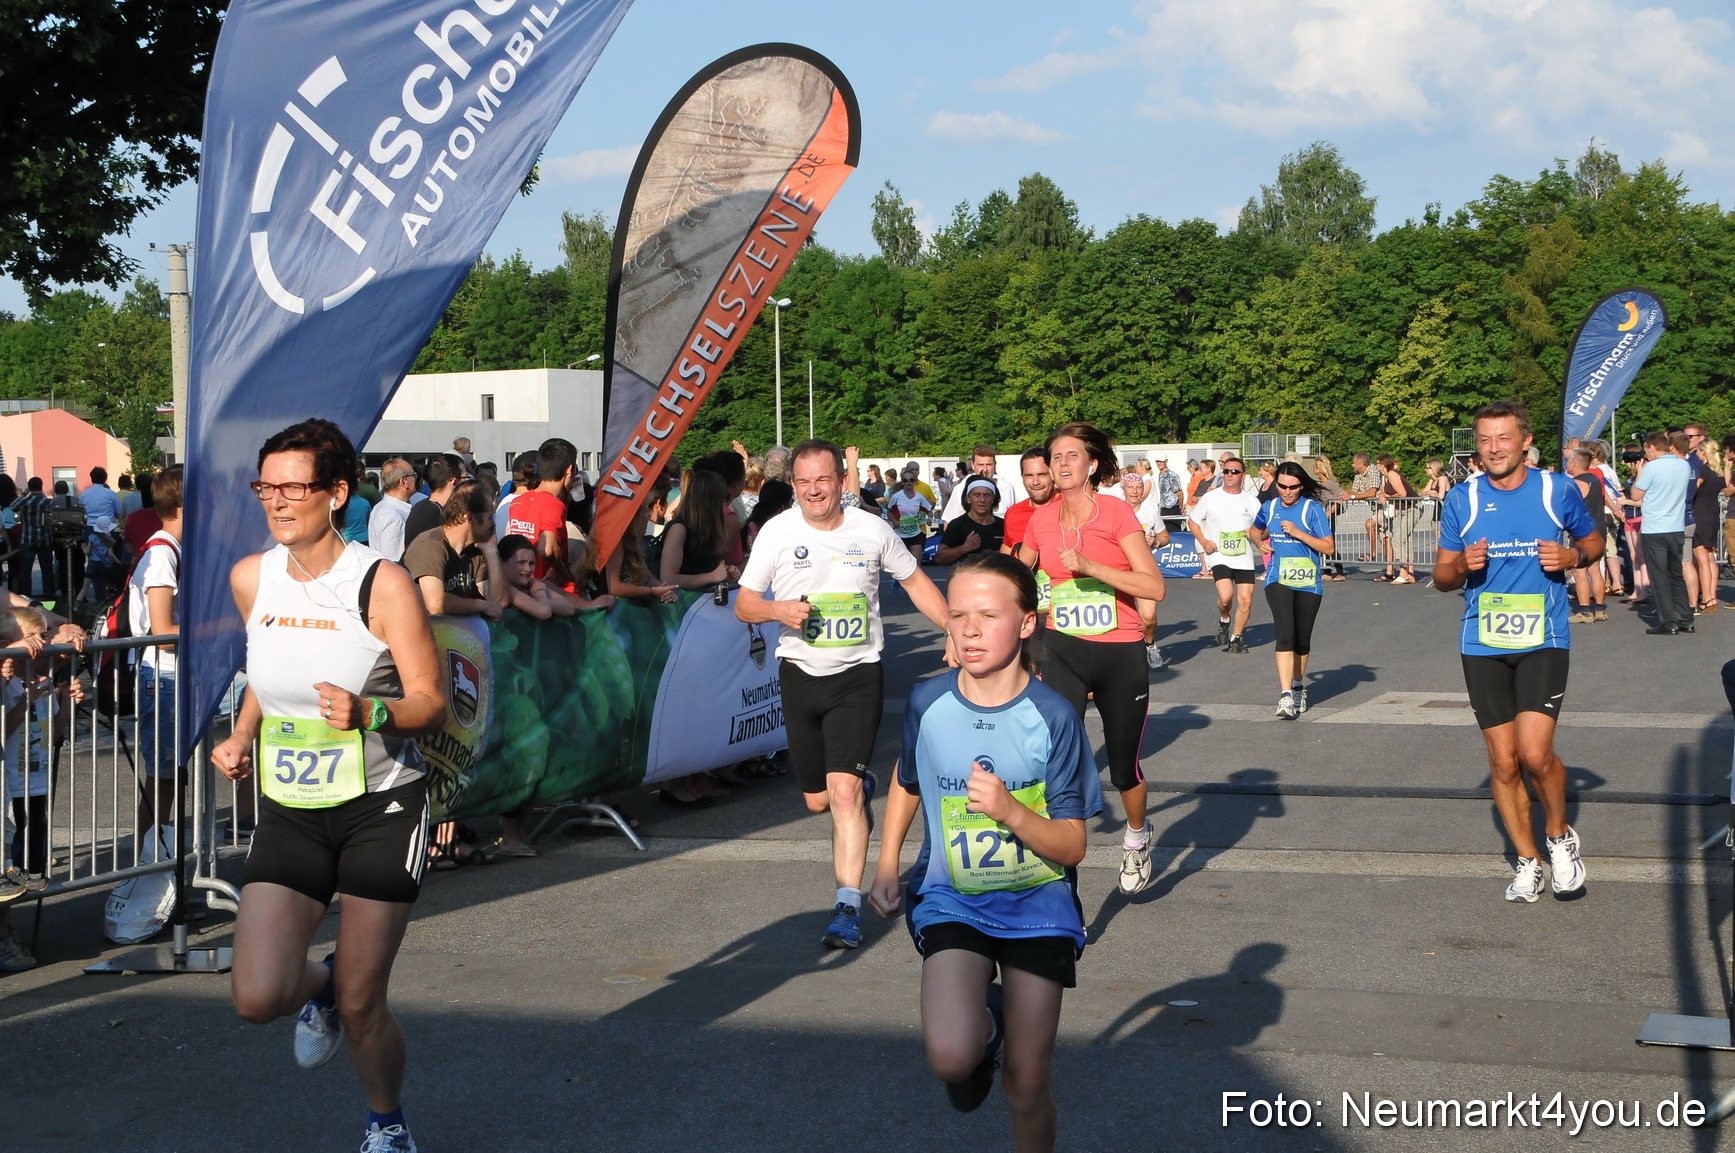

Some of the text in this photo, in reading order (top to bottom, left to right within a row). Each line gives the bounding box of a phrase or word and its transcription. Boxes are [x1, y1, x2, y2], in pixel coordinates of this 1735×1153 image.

[309, 0, 512, 255] Fisch
[1223, 539, 1242, 550] 887
[1281, 568, 1315, 581] 1294
[278, 616, 342, 631] KLEBL
[1056, 603, 1113, 629] 5100
[1481, 611, 1541, 636] 1297
[805, 617, 863, 641] 5102
[274, 748, 344, 785] 527
[1017, 872, 1035, 882] GmbH
